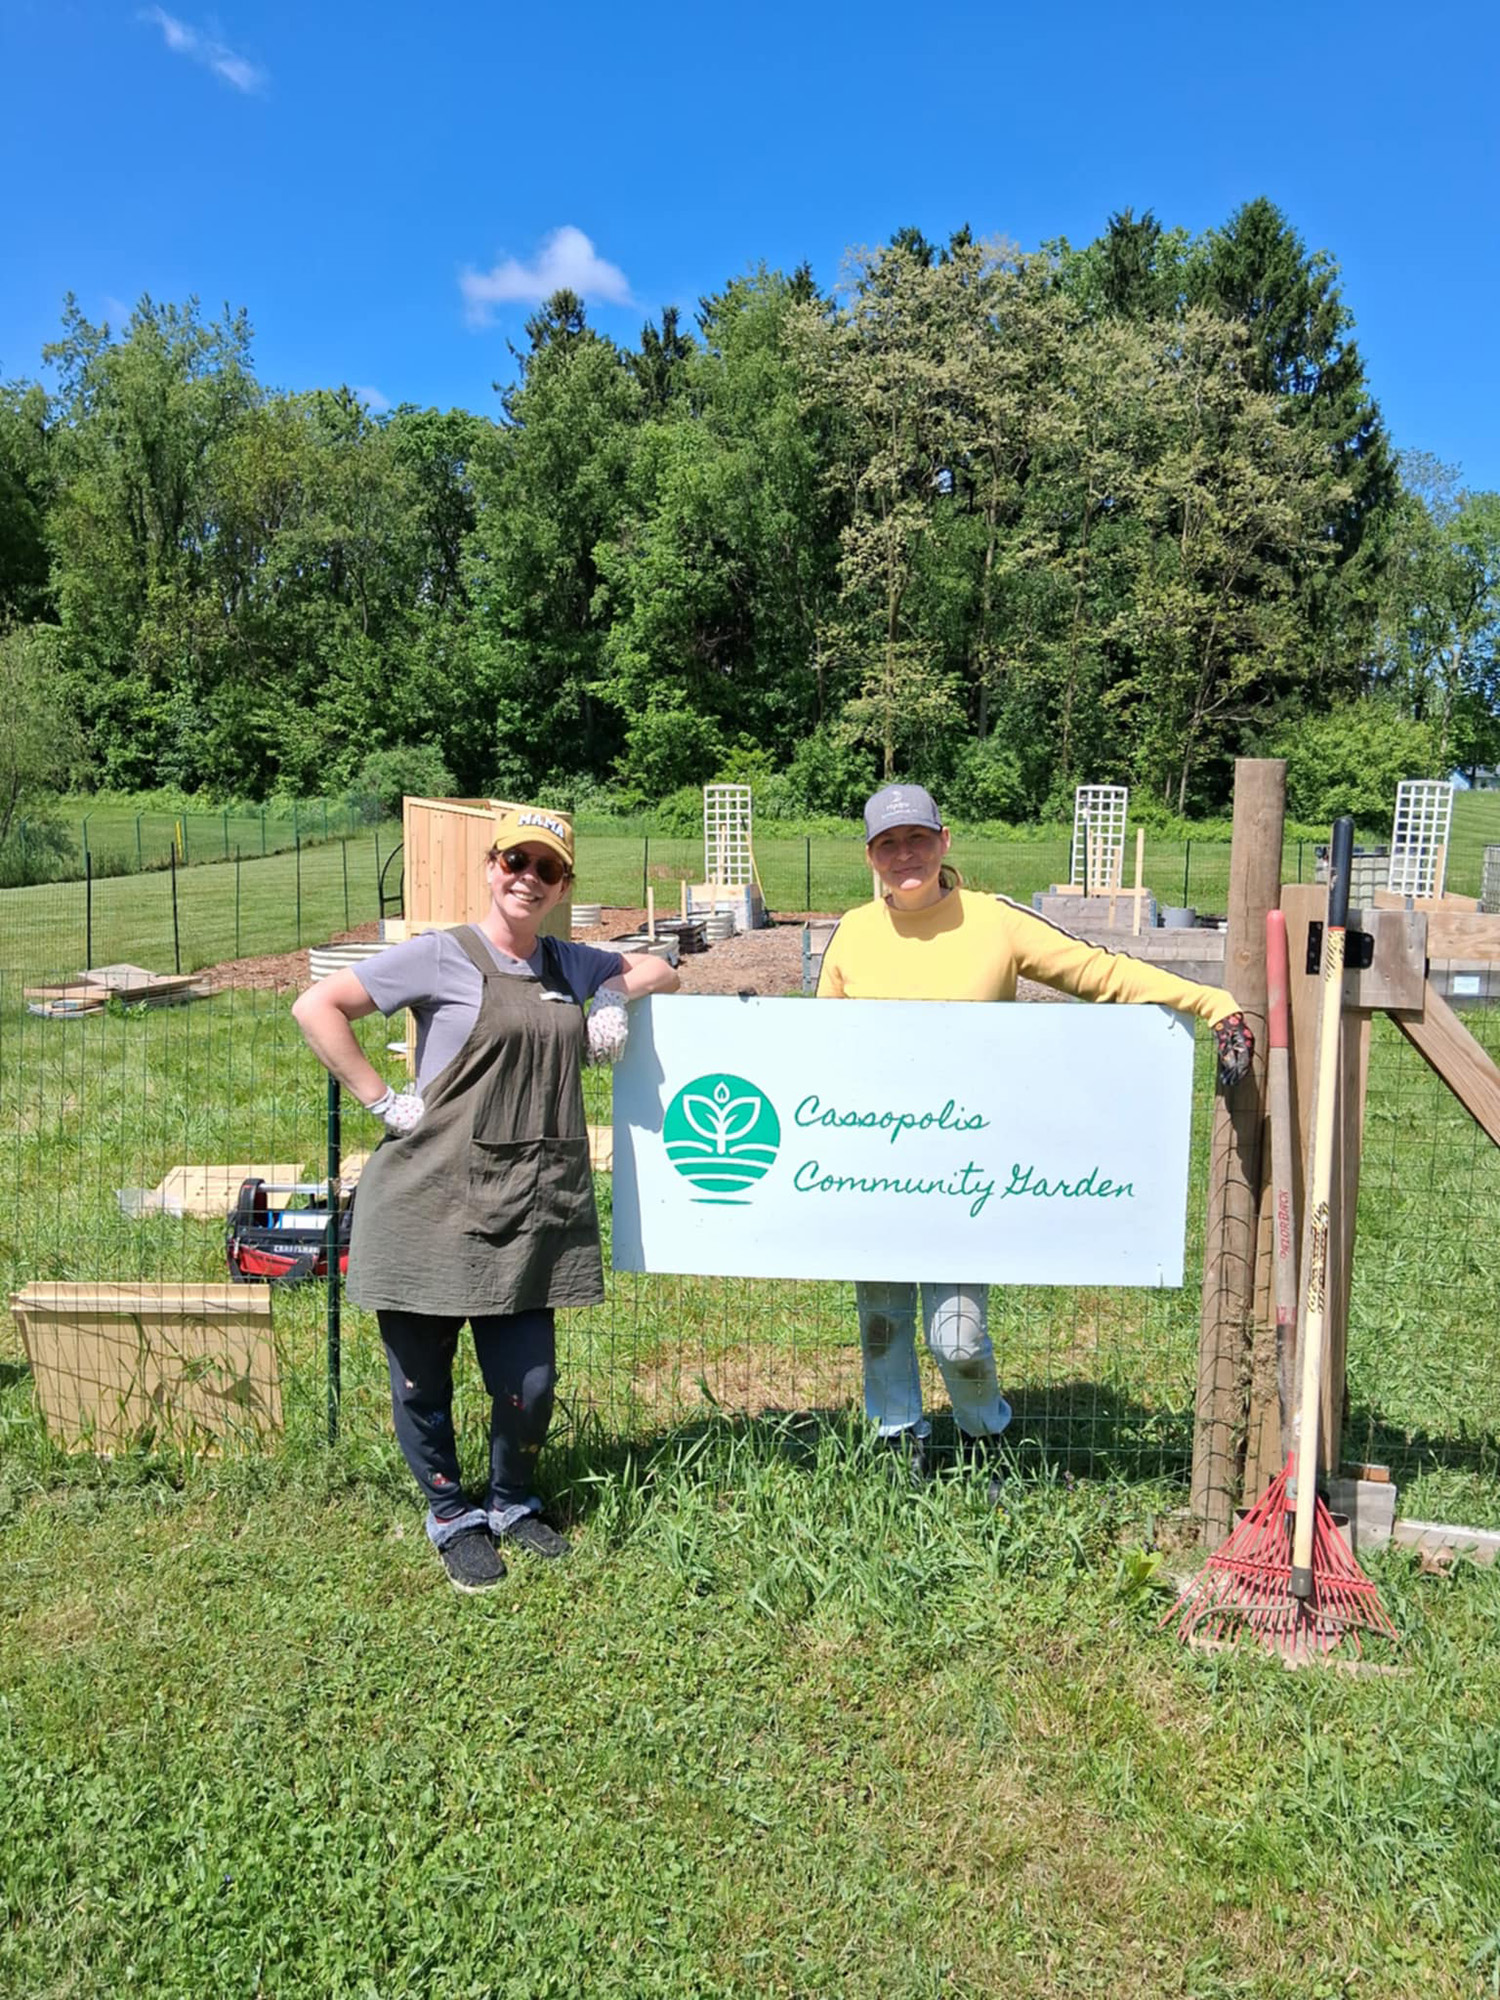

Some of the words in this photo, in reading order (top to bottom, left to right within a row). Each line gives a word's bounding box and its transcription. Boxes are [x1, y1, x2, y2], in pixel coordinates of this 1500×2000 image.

[517, 813, 565, 839] MAMA
[794, 1095, 991, 1144] Cassopolis
[793, 1160, 995, 1218] Community
[1000, 1163, 1135, 1199] Garden
